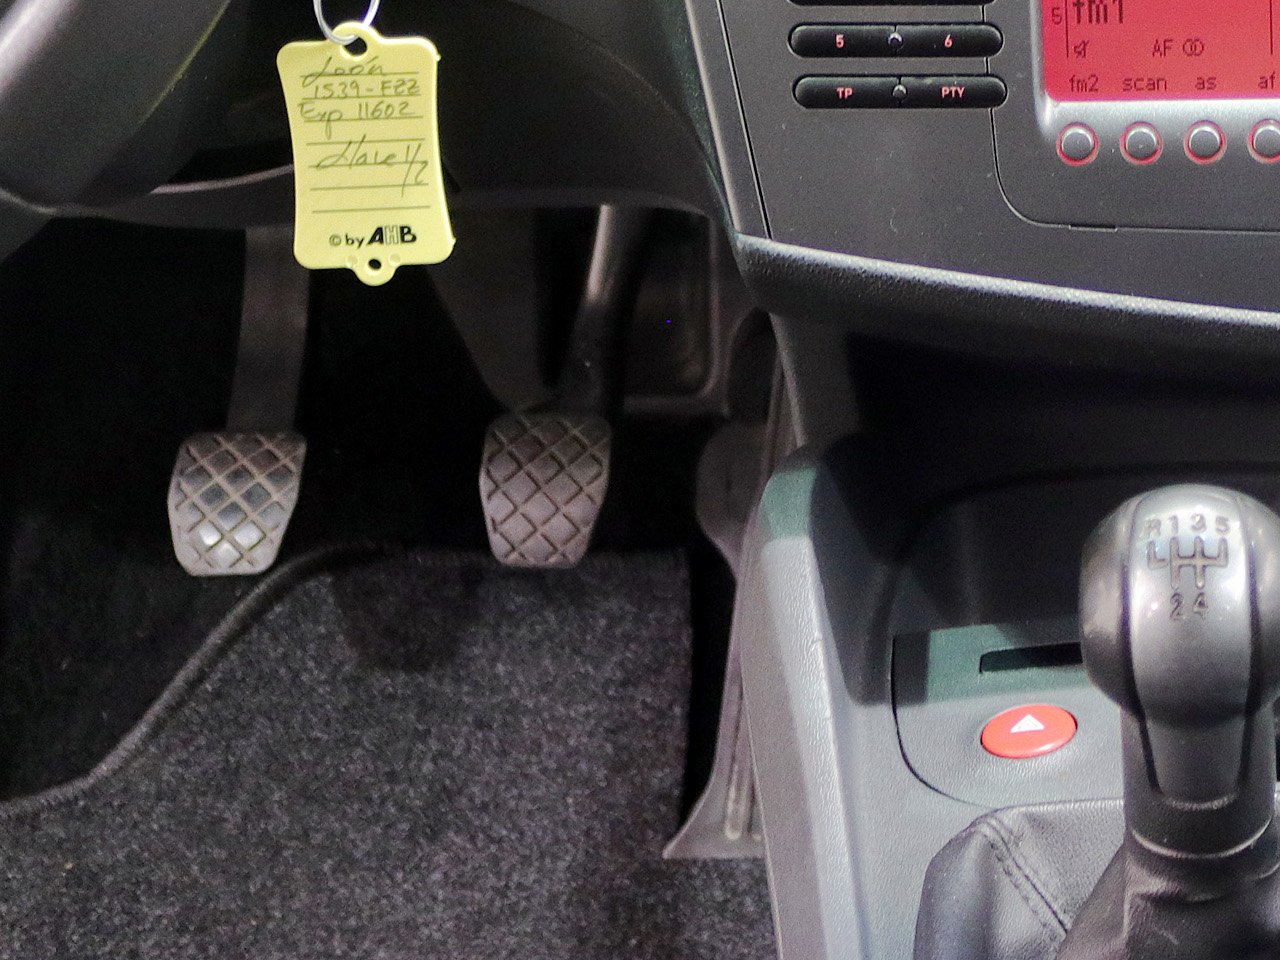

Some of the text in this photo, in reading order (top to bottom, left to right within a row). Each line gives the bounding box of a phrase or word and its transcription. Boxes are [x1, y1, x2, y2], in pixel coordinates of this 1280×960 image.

[835, 34, 845, 48] 5
[944, 34, 953, 48] 6
[1152, 39, 1172, 57] AF
[1069, 74, 1099, 91] fm2
[1122, 76, 1167, 90] scan
[1194, 76, 1217, 90] as
[1258, 72, 1276, 89] af
[837, 87, 853, 100] TP
[941, 86, 965, 99] PTY
[367, 224, 418, 246] AHB
[1169, 592, 1184, 618] 2
[1193, 592, 1208, 615] 4
